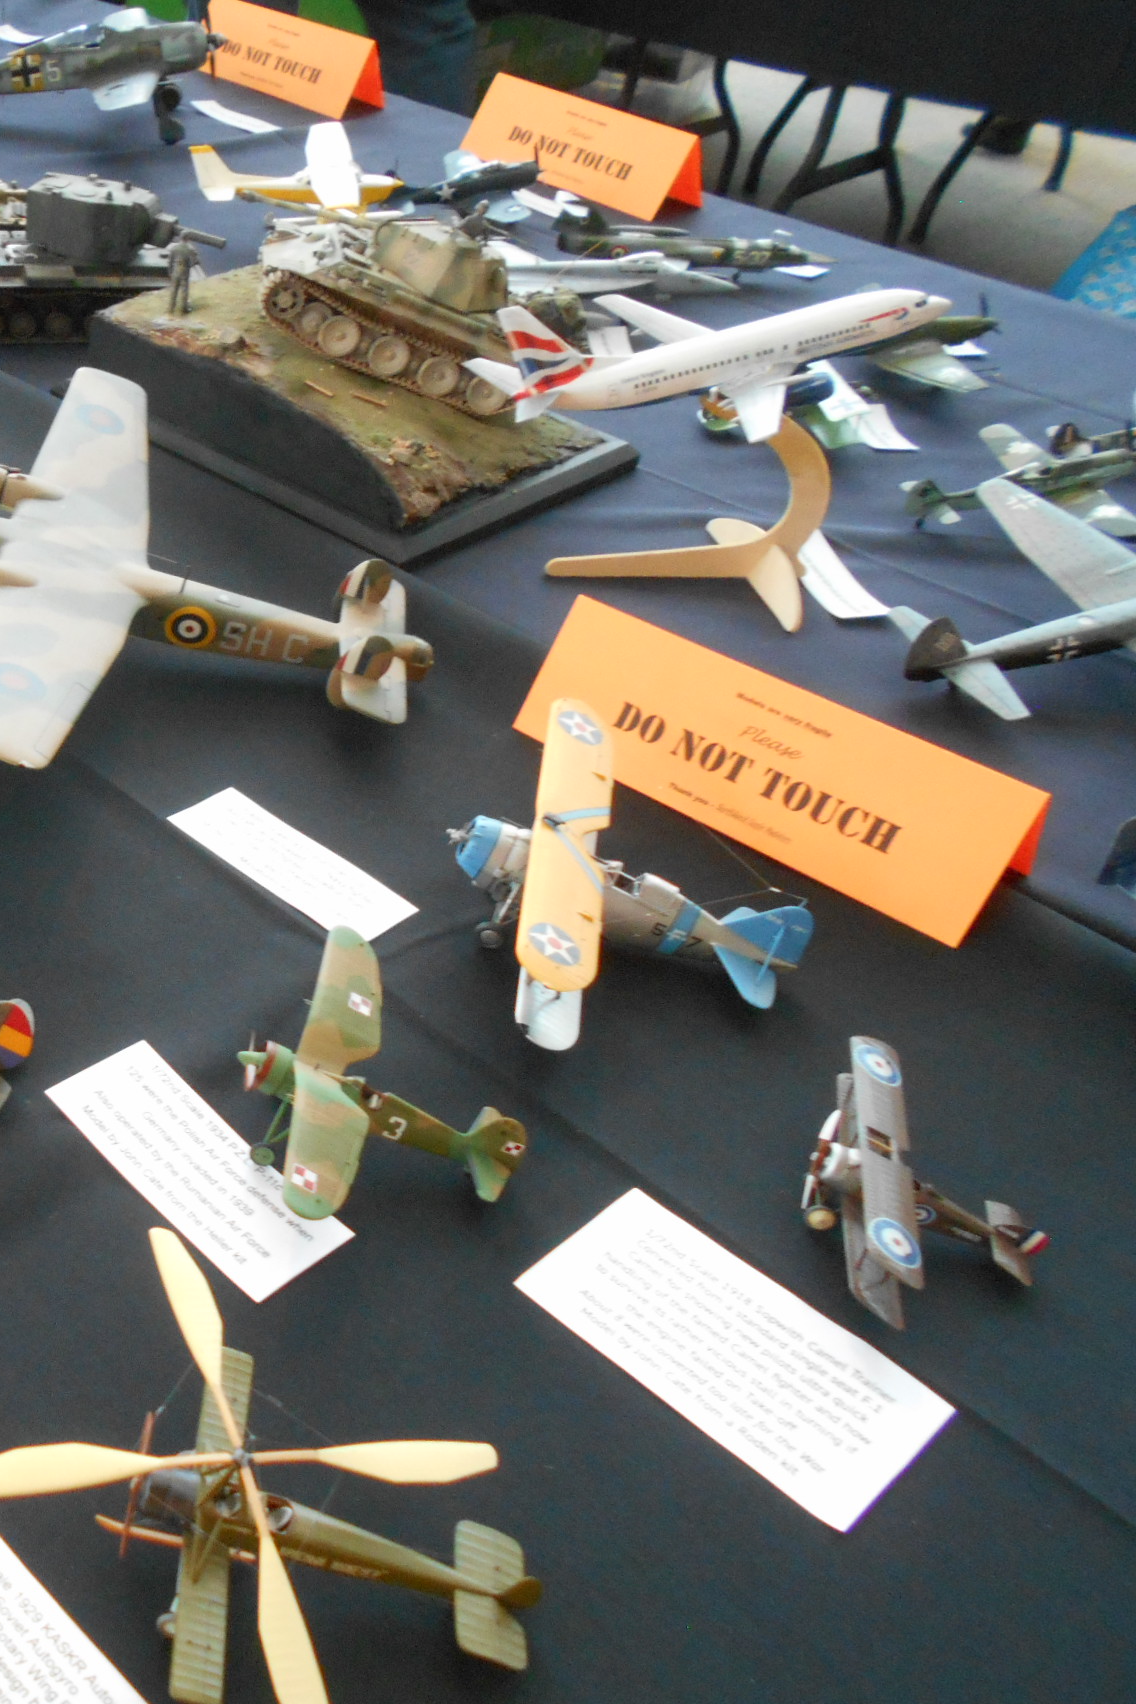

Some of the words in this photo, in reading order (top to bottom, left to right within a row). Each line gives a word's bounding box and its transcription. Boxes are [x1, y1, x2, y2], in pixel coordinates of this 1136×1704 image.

[222, 40, 242, 56] DO
[244, 46, 272, 66] NOT
[274, 56, 322, 84] TOUCH
[508, 126, 533, 145] DO
[535, 135, 570, 158] NOT
[573, 147, 633, 180] TOUCH
[739, 725, 804, 759] Please
[613, 702, 665, 743] DO
[669, 728, 755, 783] NOT
[759, 767, 903, 854] TOUCH
[686, 935, 703, 949] 7
[382, 1115, 408, 1141] 3
[13, 1593, 43, 1623] 1929
[24, 1638, 80, 1695] Autogyro
